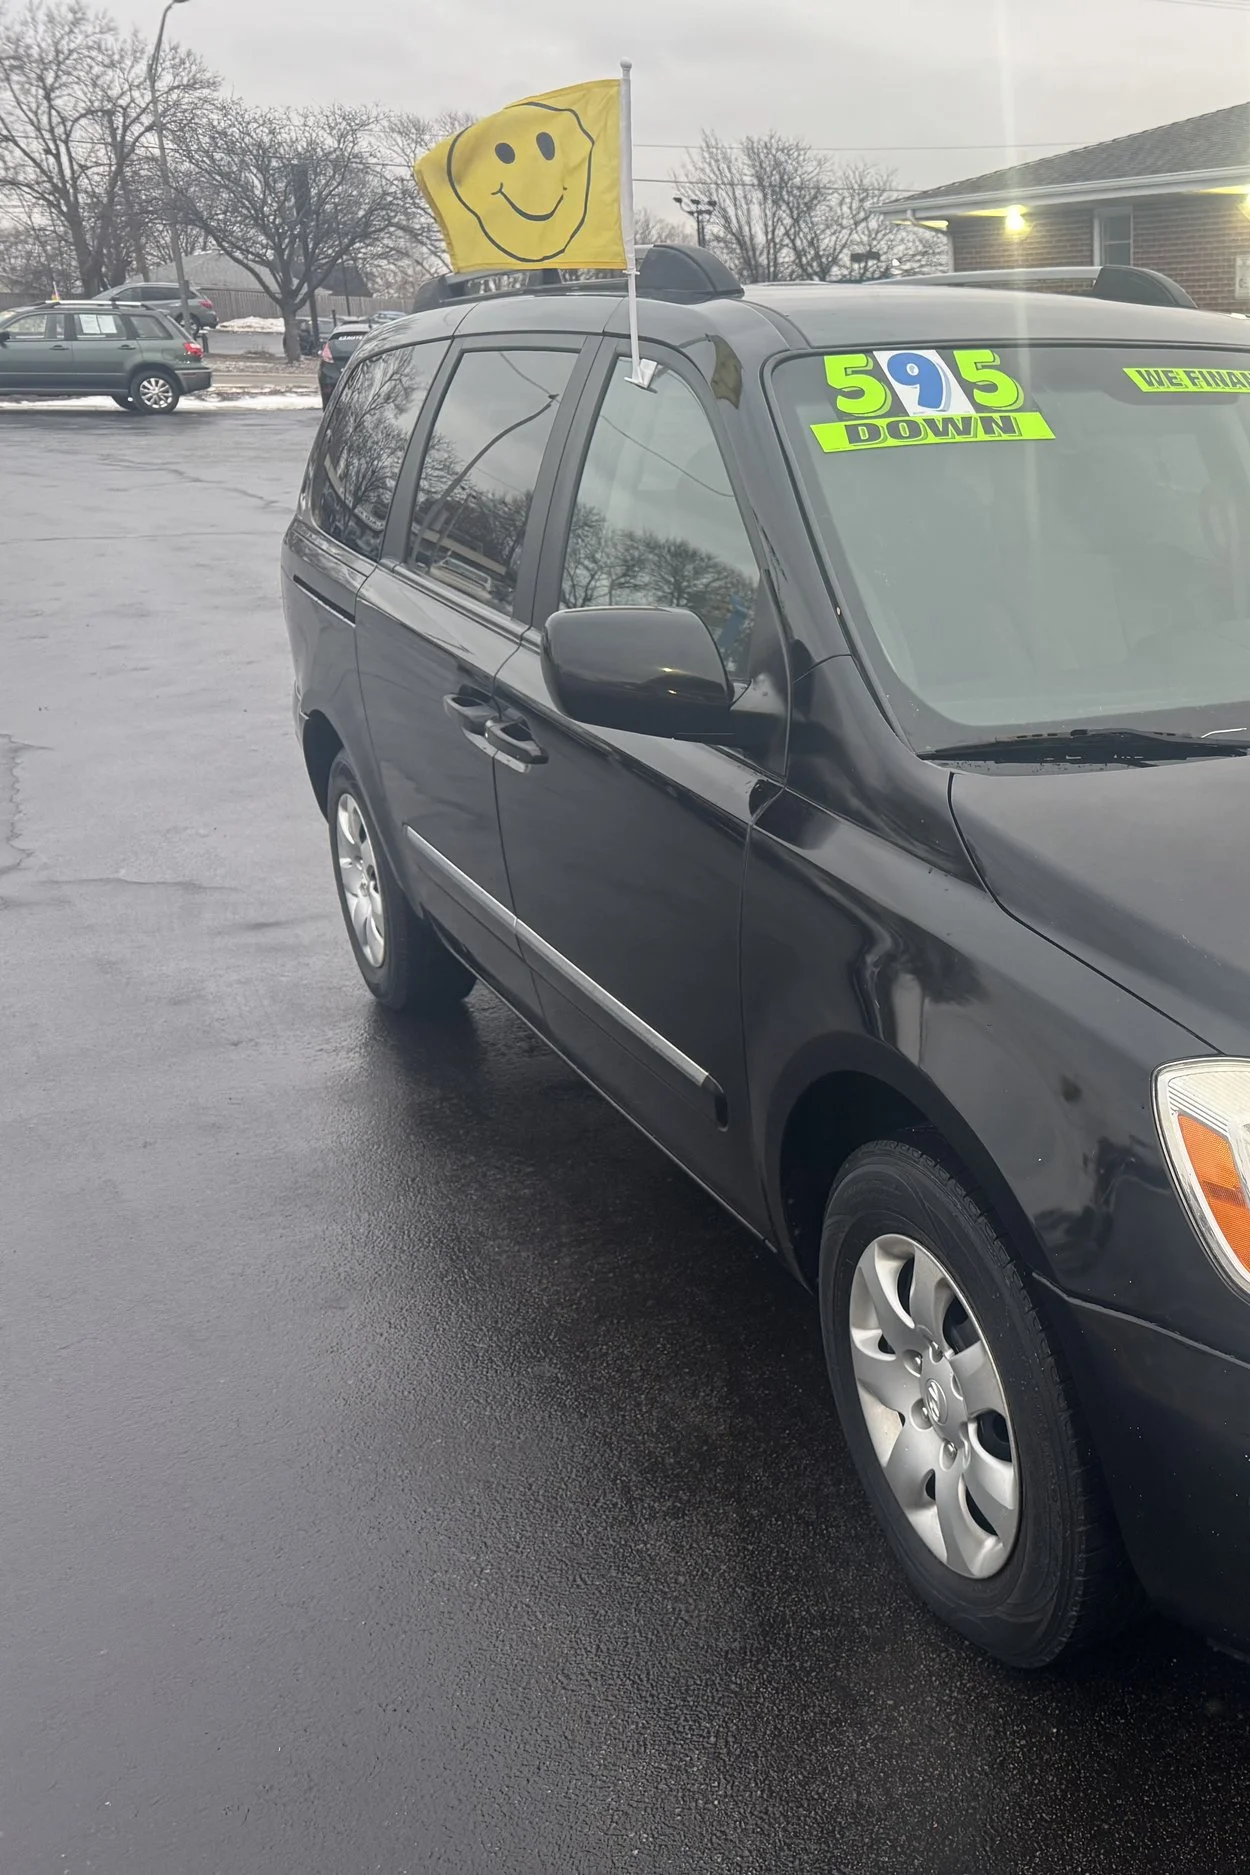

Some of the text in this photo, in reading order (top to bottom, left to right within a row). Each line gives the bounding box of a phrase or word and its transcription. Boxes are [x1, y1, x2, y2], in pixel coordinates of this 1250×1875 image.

[824, 350, 1024, 417] 595
[1136, 369, 1187, 389] WE
[845, 415, 1023, 446] DOWN
